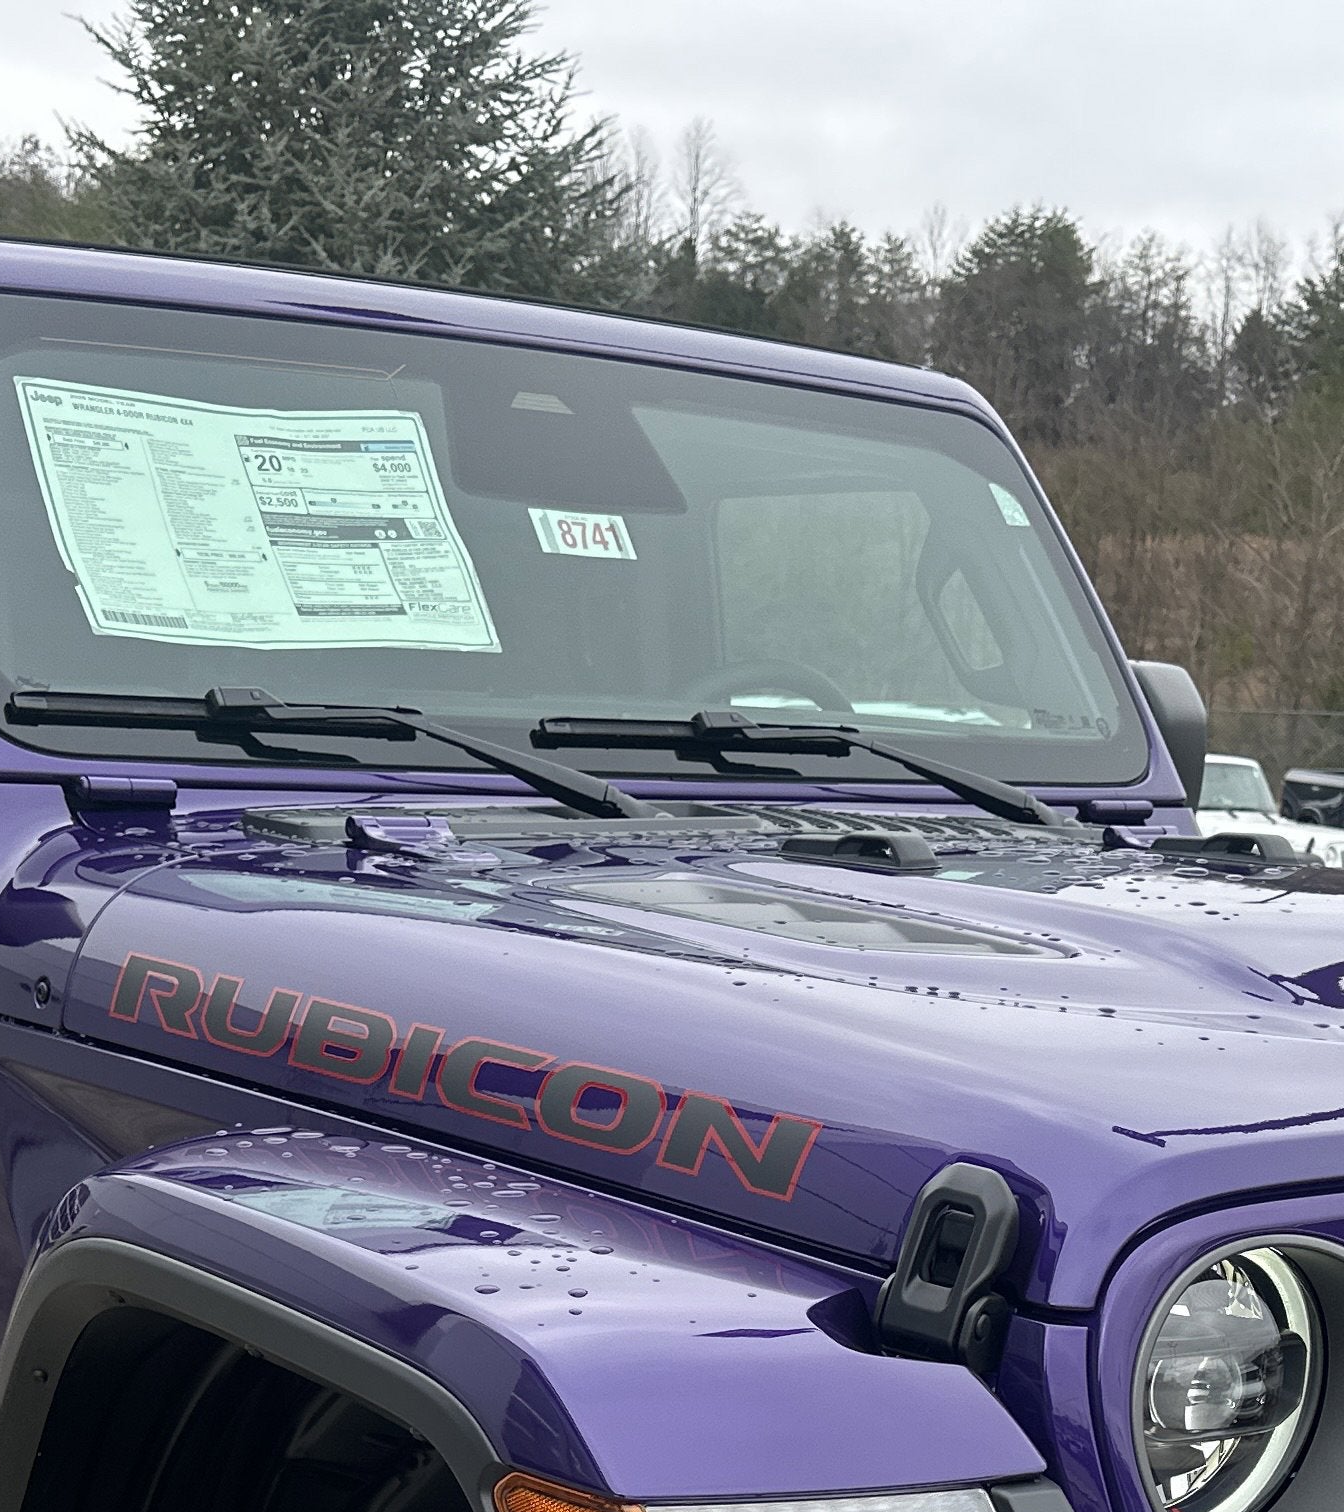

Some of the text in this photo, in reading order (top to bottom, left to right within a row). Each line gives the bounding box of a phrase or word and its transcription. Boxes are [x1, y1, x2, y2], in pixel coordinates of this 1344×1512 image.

[30, 390, 63, 406] Jeep
[72, 402, 115, 415] WRANGLER
[145, 412, 179, 424] RUBICON
[264, 438, 291, 448] Economy
[254, 454, 282, 472] 20
[381, 454, 406, 462] spend
[373, 462, 412, 473] $4,000
[258, 496, 299, 508] $2,500
[558, 519, 624, 552] 8741
[408, 602, 472, 614] FlexCare
[108, 950, 824, 1202] RUBICON
